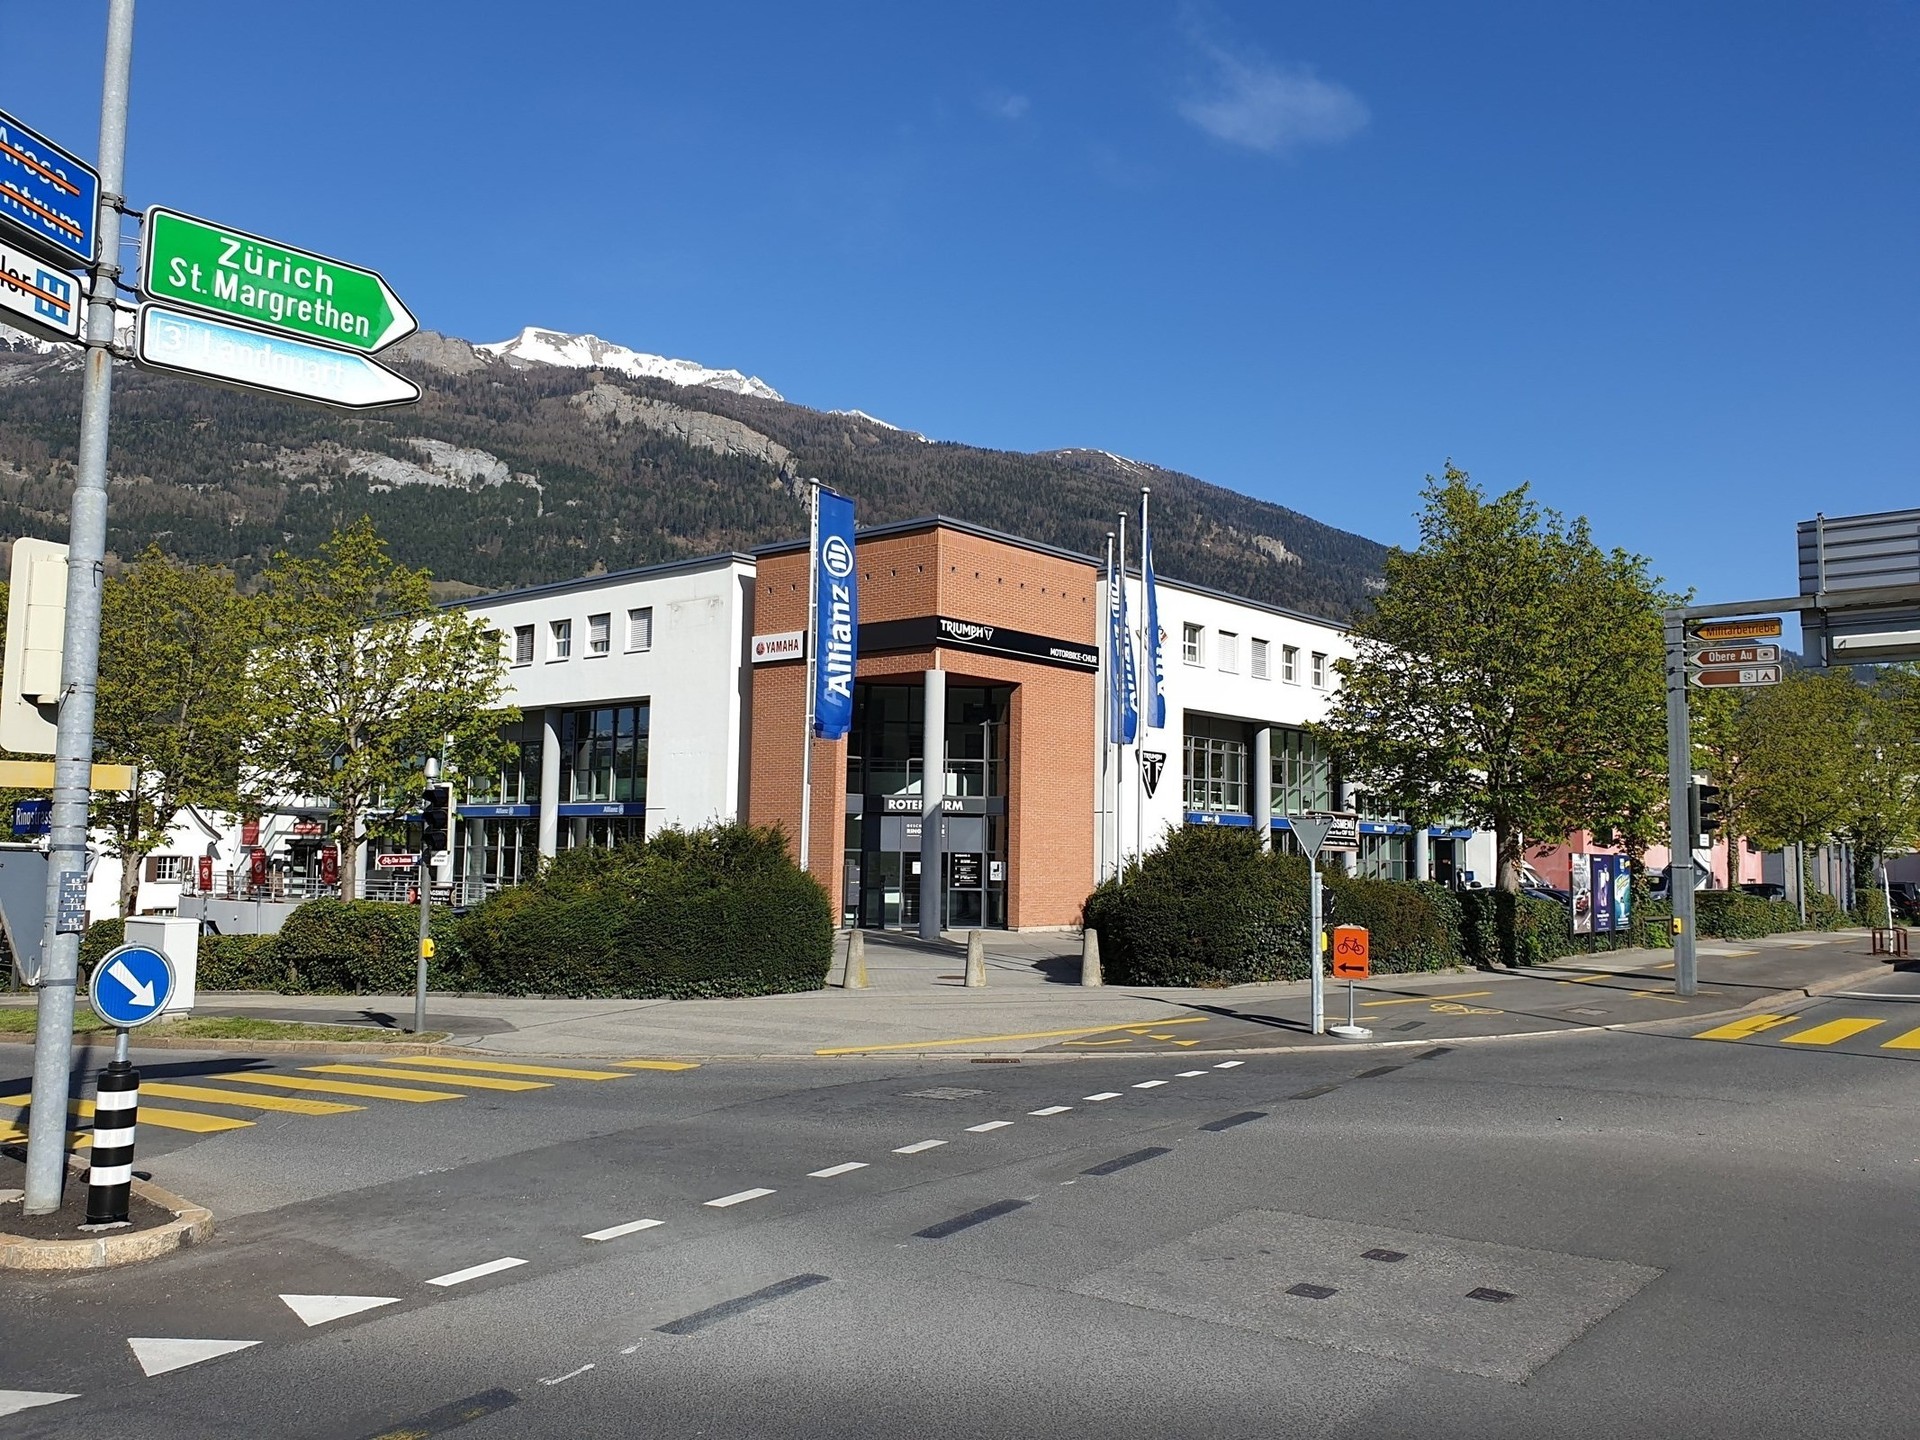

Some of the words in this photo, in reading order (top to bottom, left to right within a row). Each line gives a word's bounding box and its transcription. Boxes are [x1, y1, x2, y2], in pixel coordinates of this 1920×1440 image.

[0, 180, 82, 244] ntrum
[218, 237, 334, 296] Zürich
[168, 257, 208, 294] St.
[214, 269, 370, 338] Margrethen
[163, 326, 182, 350] 3
[202, 329, 346, 386] Landquart
[940, 619, 984, 641] TRIUMPH
[1706, 623, 1776, 637] Militärbetriebe
[765, 638, 799, 654] YAMAHA
[827, 585, 852, 699] Allianz
[1049, 647, 1097, 663] MOTORBIKE-CHUR
[1708, 651, 1736, 662] Obere
[1740, 650, 1753, 660] Au
[15, 807, 52, 830] Ringstrass
